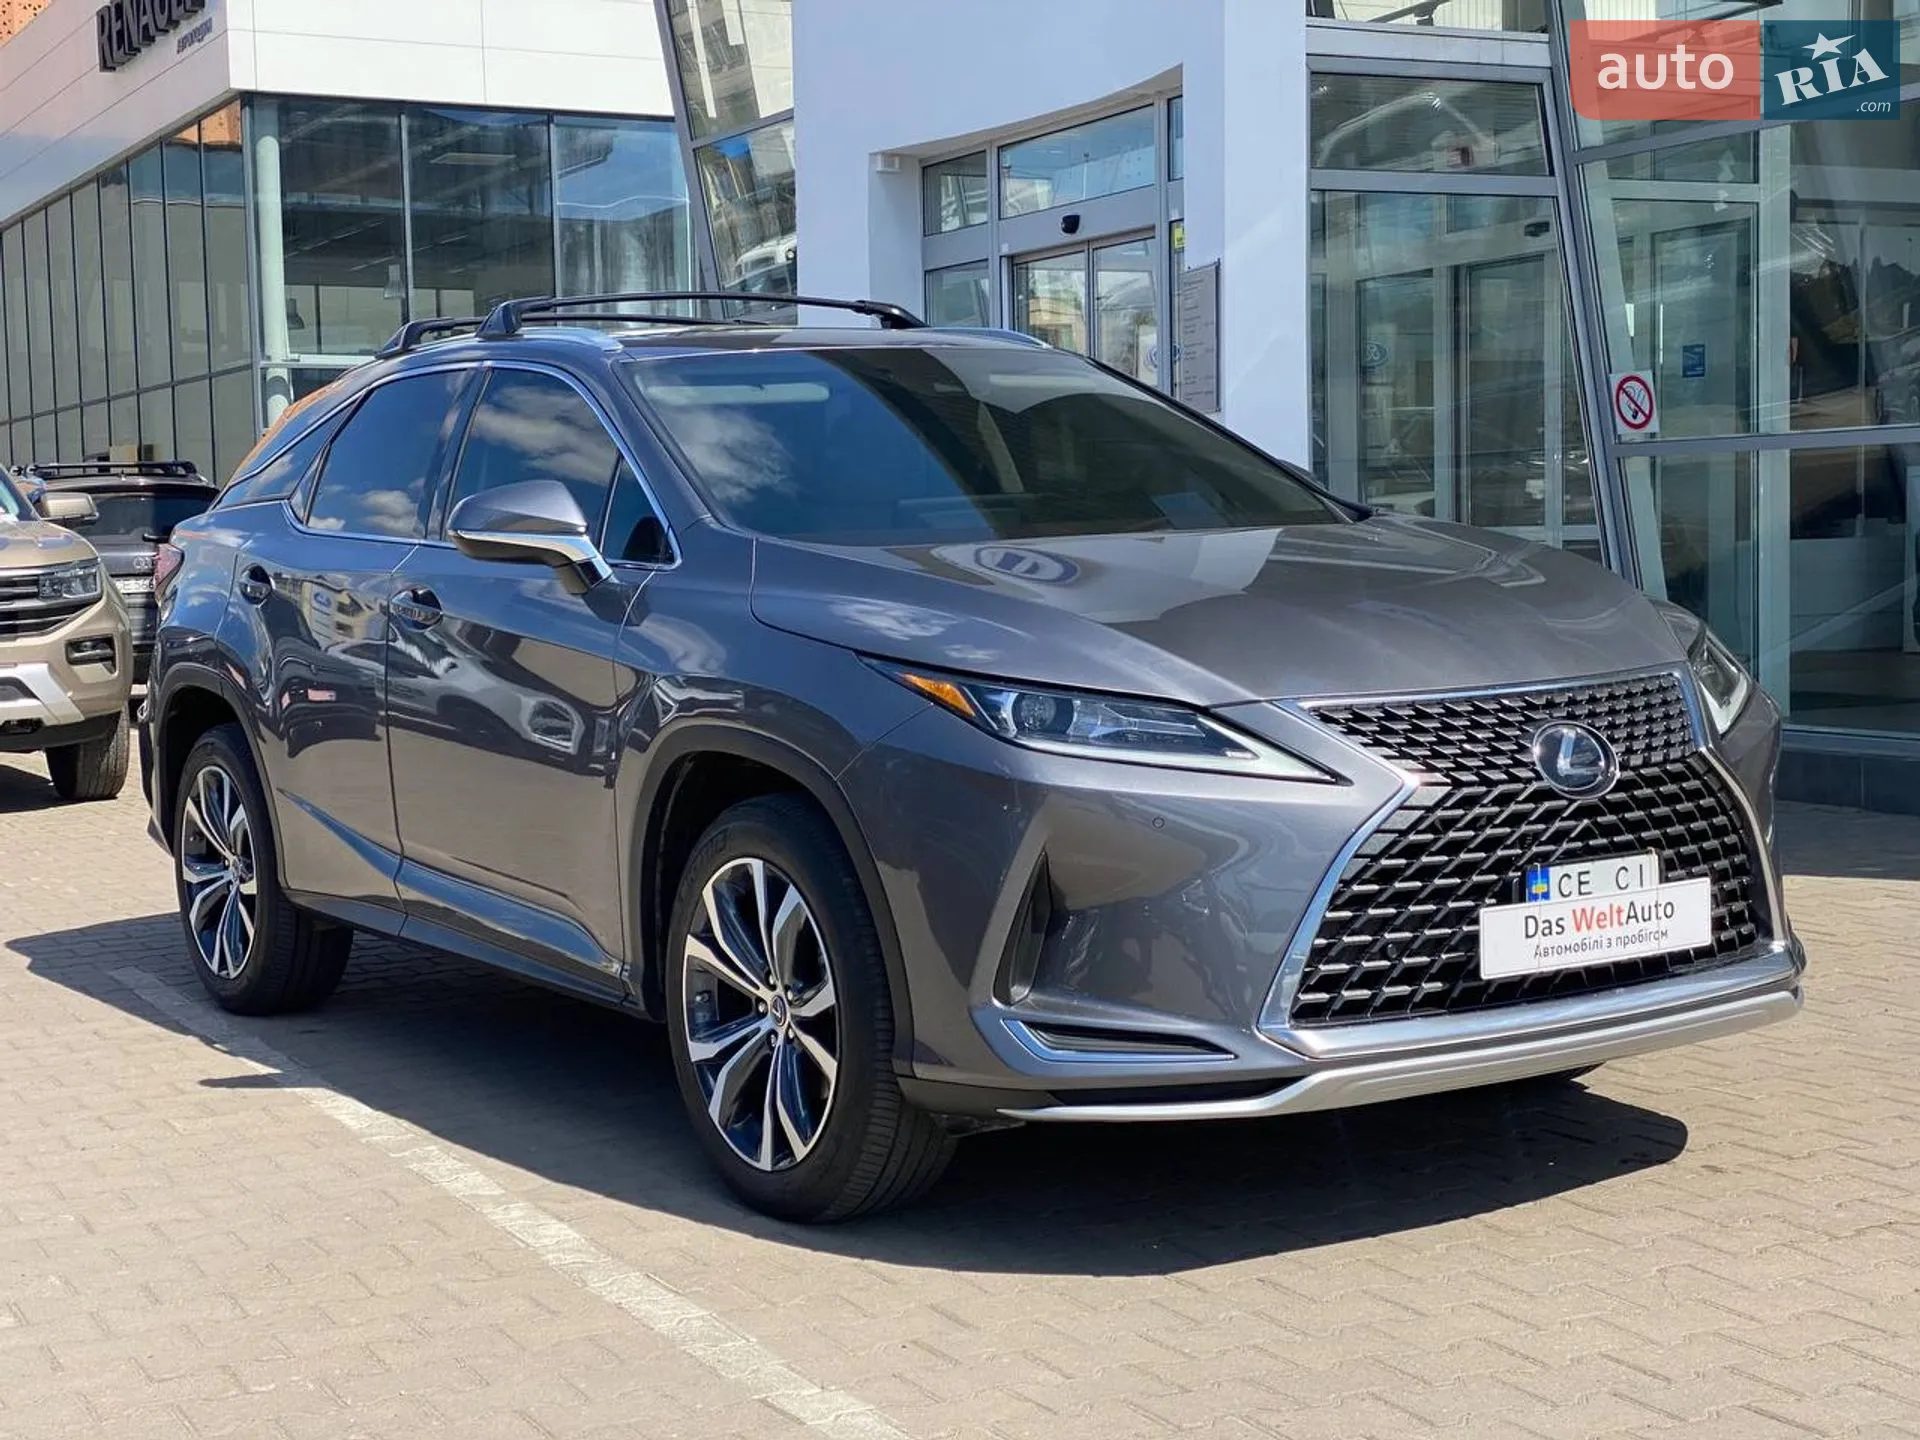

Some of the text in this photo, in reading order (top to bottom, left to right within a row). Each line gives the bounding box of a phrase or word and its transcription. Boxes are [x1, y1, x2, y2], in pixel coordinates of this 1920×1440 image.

[96, 0, 205, 72] RENAU
[1558, 870, 1593, 898] CE
[1524, 900, 1675, 939] Das WeltAuto
[1533, 928, 1669, 959] Автомобілі з пробігом
